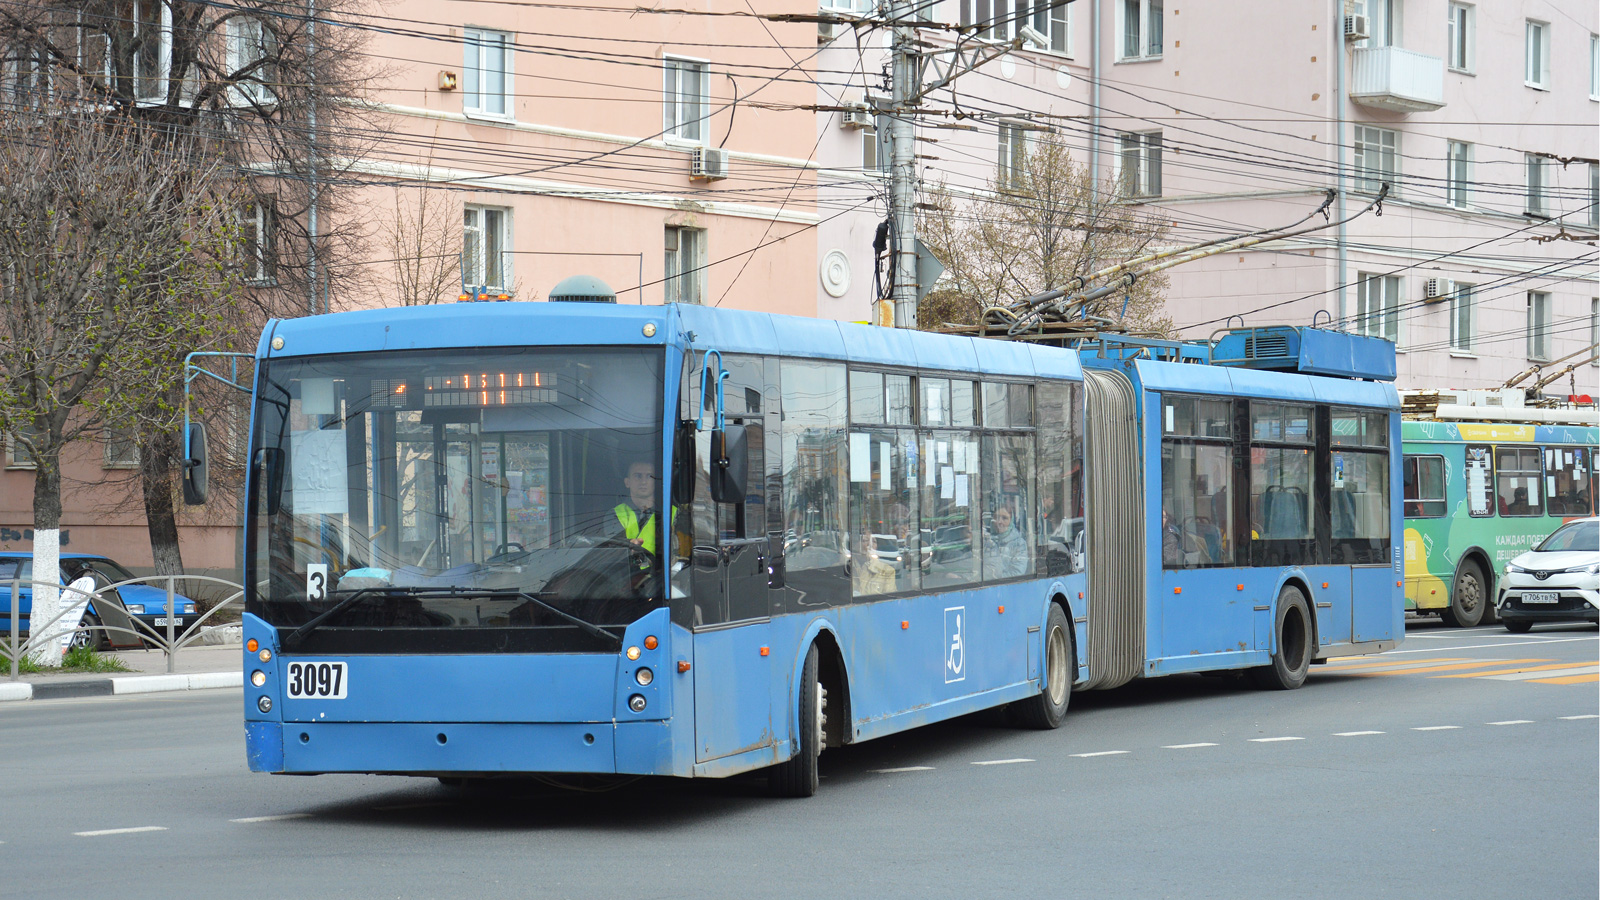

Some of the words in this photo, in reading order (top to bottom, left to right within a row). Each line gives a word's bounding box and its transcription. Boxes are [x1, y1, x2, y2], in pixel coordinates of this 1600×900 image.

[1495, 535, 1525, 546] КАЖДАЯ
[309, 571, 325, 601] 3
[289, 663, 343, 696] 3097
